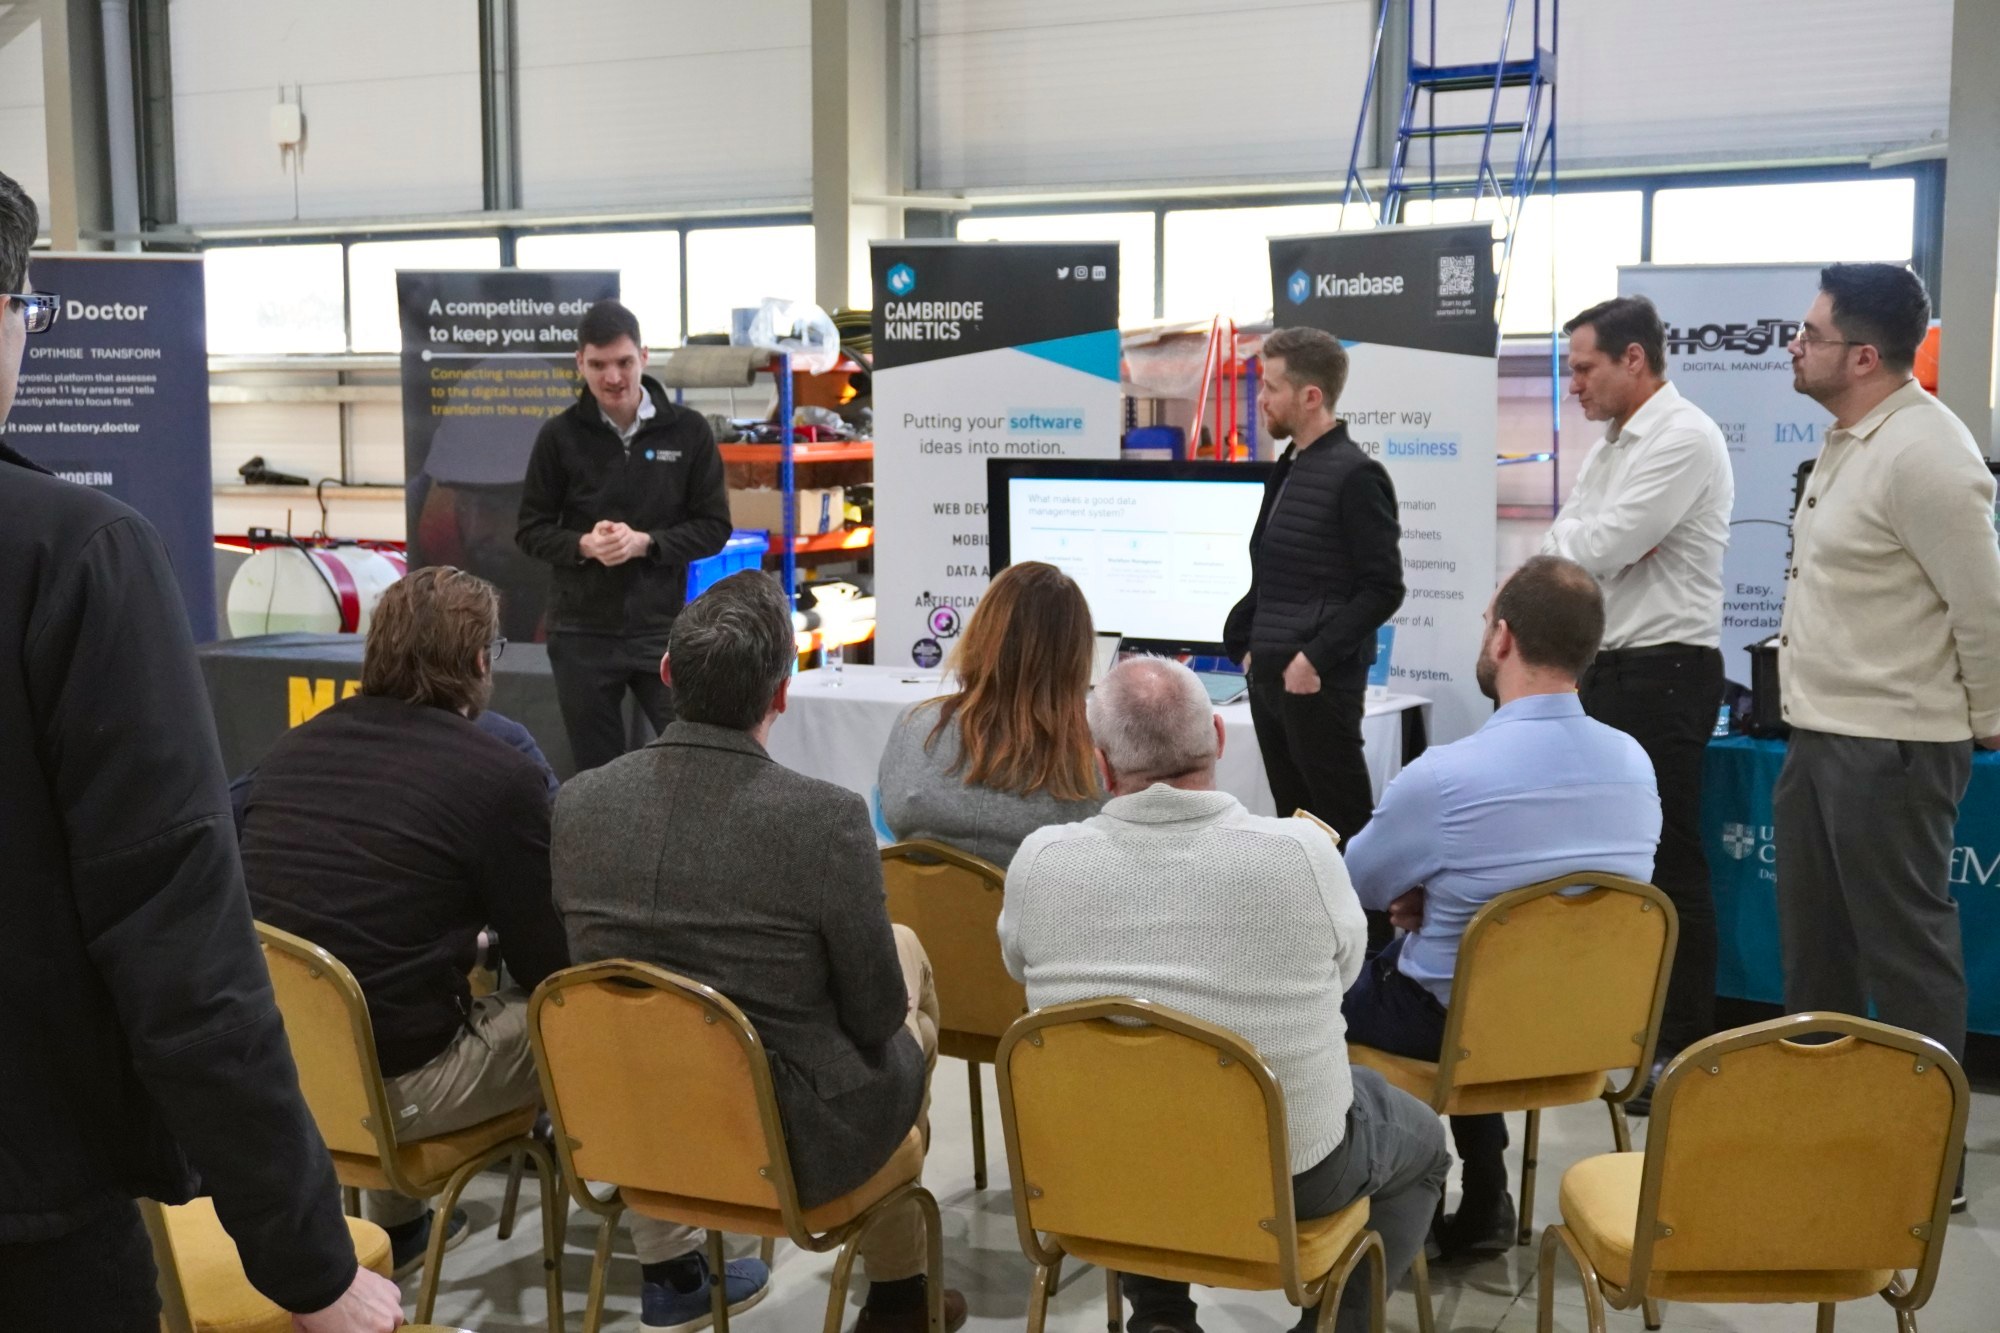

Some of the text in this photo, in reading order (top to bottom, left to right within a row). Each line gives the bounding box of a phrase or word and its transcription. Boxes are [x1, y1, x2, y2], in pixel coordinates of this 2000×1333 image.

[1316, 272, 1404, 298] Kinabase
[66, 300, 148, 321] Doctor
[428, 300, 442, 315] A
[446, 298, 554, 320] competitive
[884, 301, 984, 320] CAMBRIDGE
[429, 326, 449, 342] to
[452, 325, 498, 346] keep
[502, 329, 535, 346] you
[884, 321, 962, 340] KINETICS
[30, 348, 161, 360] OPTIMISE TRANSFORM
[1682, 362, 1727, 372] DIGITAL
[54, 374, 93, 384] platform
[95, 374, 114, 383] that
[116, 375, 157, 383] assesses
[430, 368, 504, 382] Connecting
[506, 368, 549, 379] makers
[552, 368, 574, 379] like
[59, 386, 68, 395] 11
[71, 386, 86, 397] key
[116, 386, 133, 395] and
[135, 386, 154, 395] tells
[431, 386, 445, 398] to
[448, 386, 469, 398] the
[472, 386, 510, 400] digital
[512, 386, 544, 398] tools
[547, 386, 574, 398] that
[45, 398, 72, 406] where
[74, 398, 84, 406] to
[86, 398, 112, 406] focus
[113, 398, 134, 406] first.
[431, 404, 566, 418] transform the way yo
[904, 413, 1084, 432] Putting your software
[1400, 410, 1432, 428] way
[8, 422, 16, 432] it
[18, 424, 43, 432] now
[45, 422, 57, 432] at
[58, 422, 140, 434] factory.doctor
[1733, 422, 1745, 431] OF
[1775, 422, 1814, 443] IfM
[920, 438, 1066, 455] ideas into motion.
[1388, 438, 1458, 456] business
[1028, 494, 1136, 508] What makes a good data
[933, 503, 961, 515] WEB
[1028, 508, 1125, 519] management system?
[946, 565, 978, 577] DATA
[1404, 558, 1456, 572] happening
[1412, 589, 1464, 601] processes
[1736, 583, 1774, 596] Easy.
[1412, 616, 1421, 626] of
[1424, 616, 1434, 627] AI
[1722, 616, 1782, 628] ffordabl
[1410, 668, 1454, 682] system.
